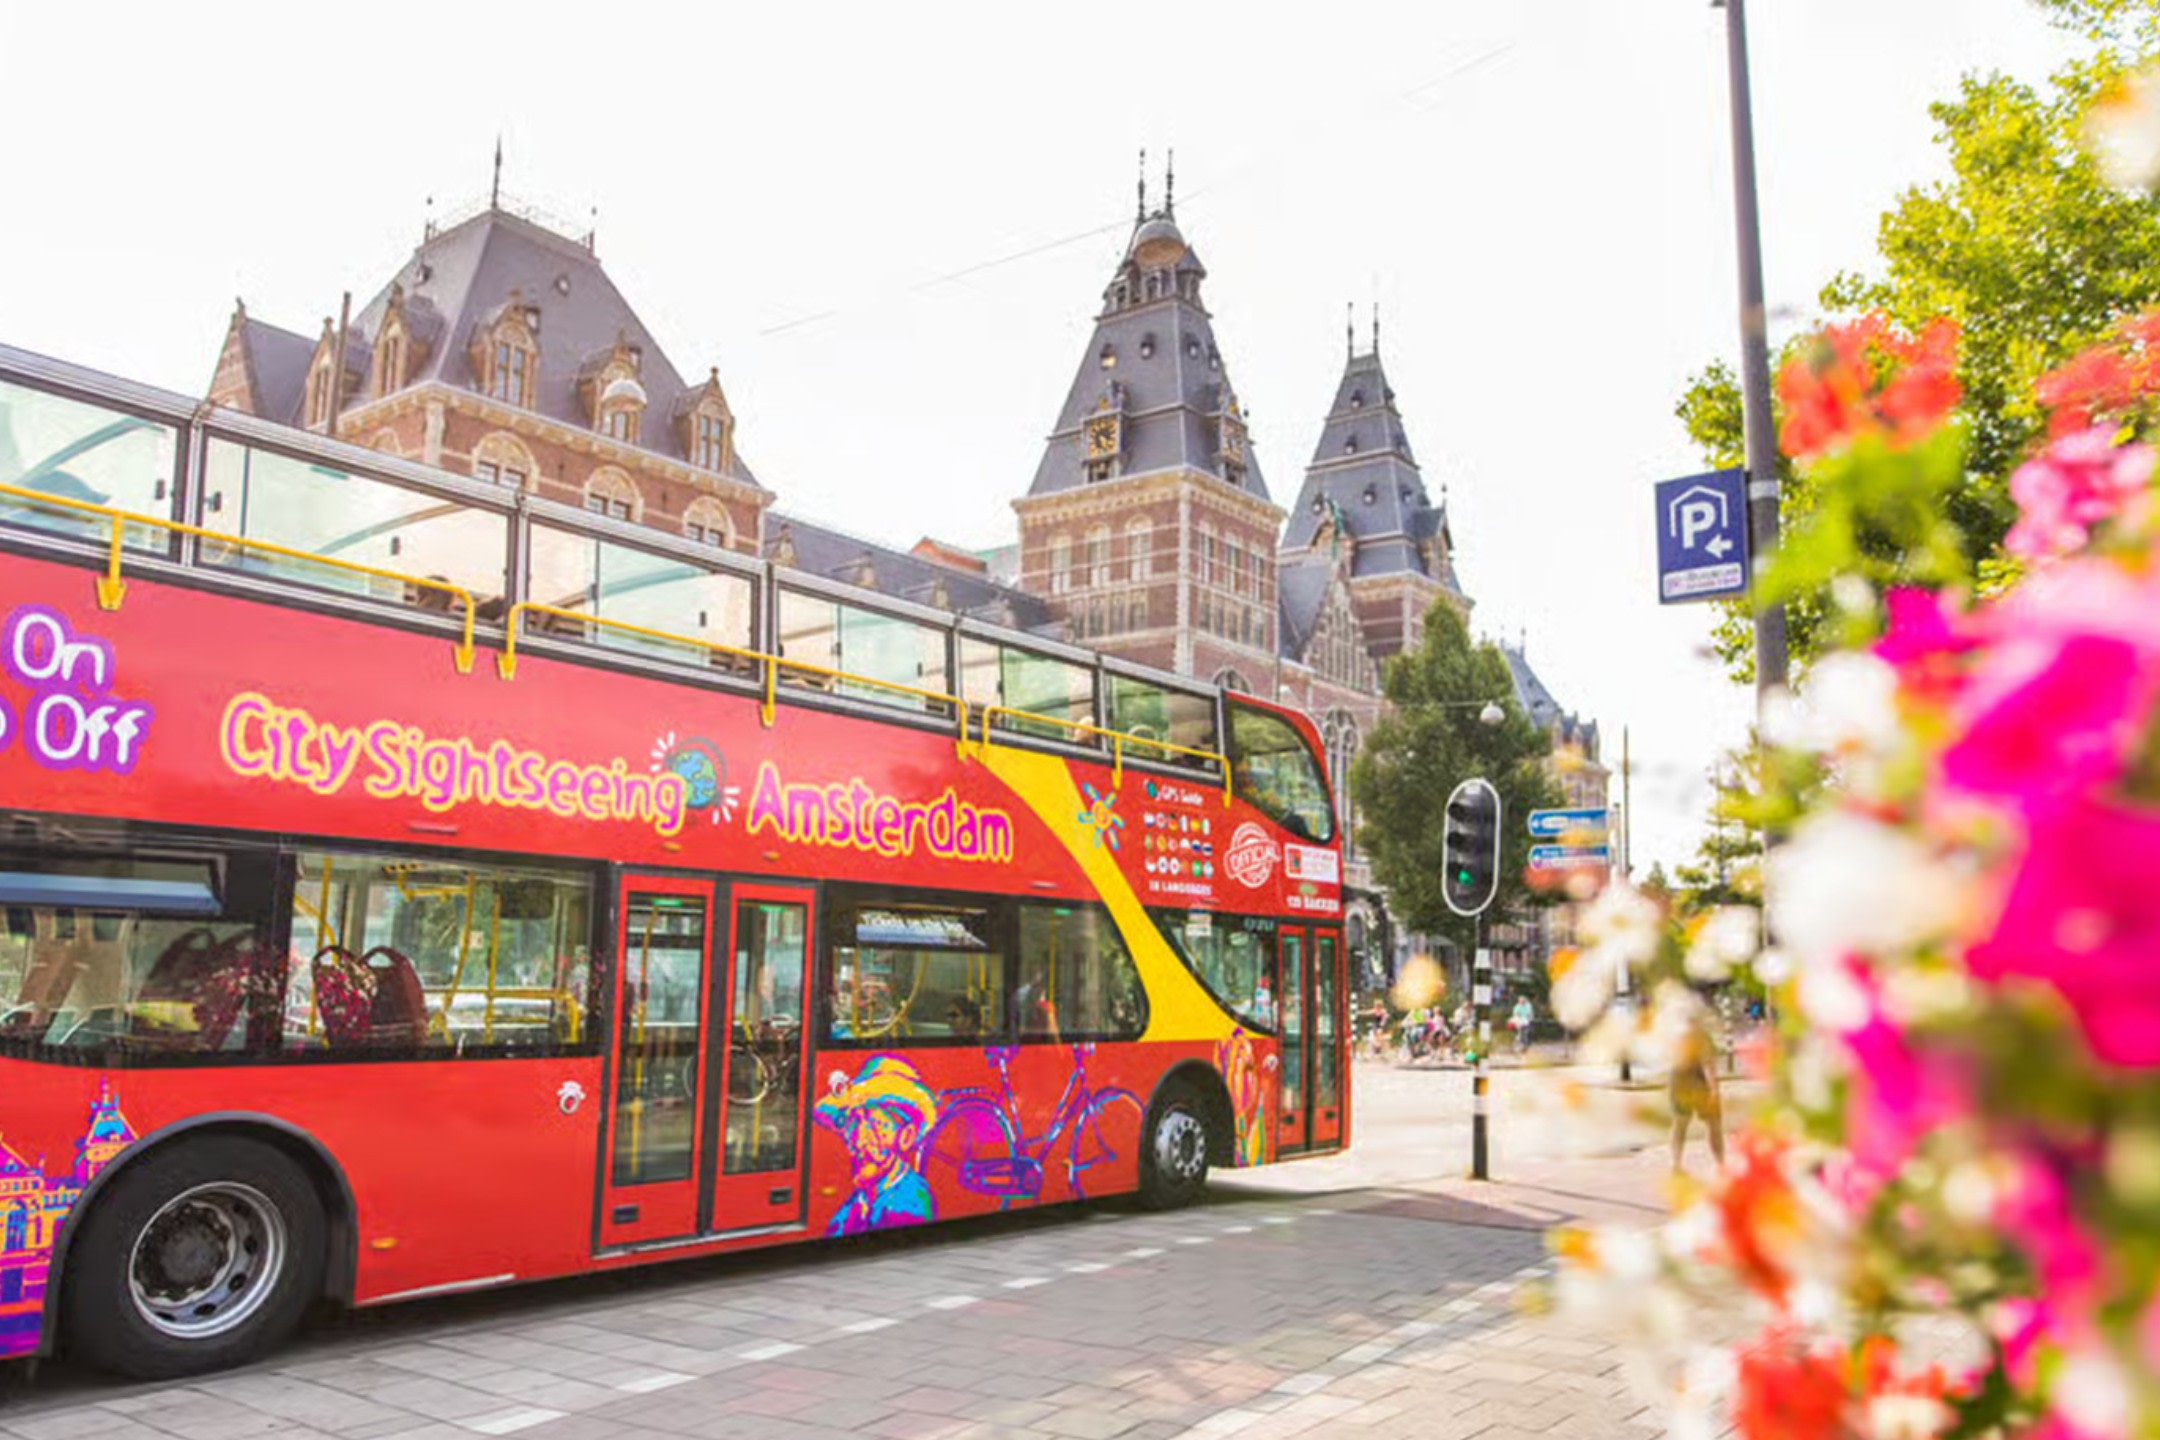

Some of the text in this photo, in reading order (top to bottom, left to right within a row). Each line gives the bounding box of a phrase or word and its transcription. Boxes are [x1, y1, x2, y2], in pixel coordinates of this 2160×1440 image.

[1681, 501, 1716, 549] P
[13, 612, 105, 685] On
[36, 693, 147, 765] Off
[747, 760, 1013, 863] Amsterdam
[1229, 844, 1276, 873] OFFICIAL
